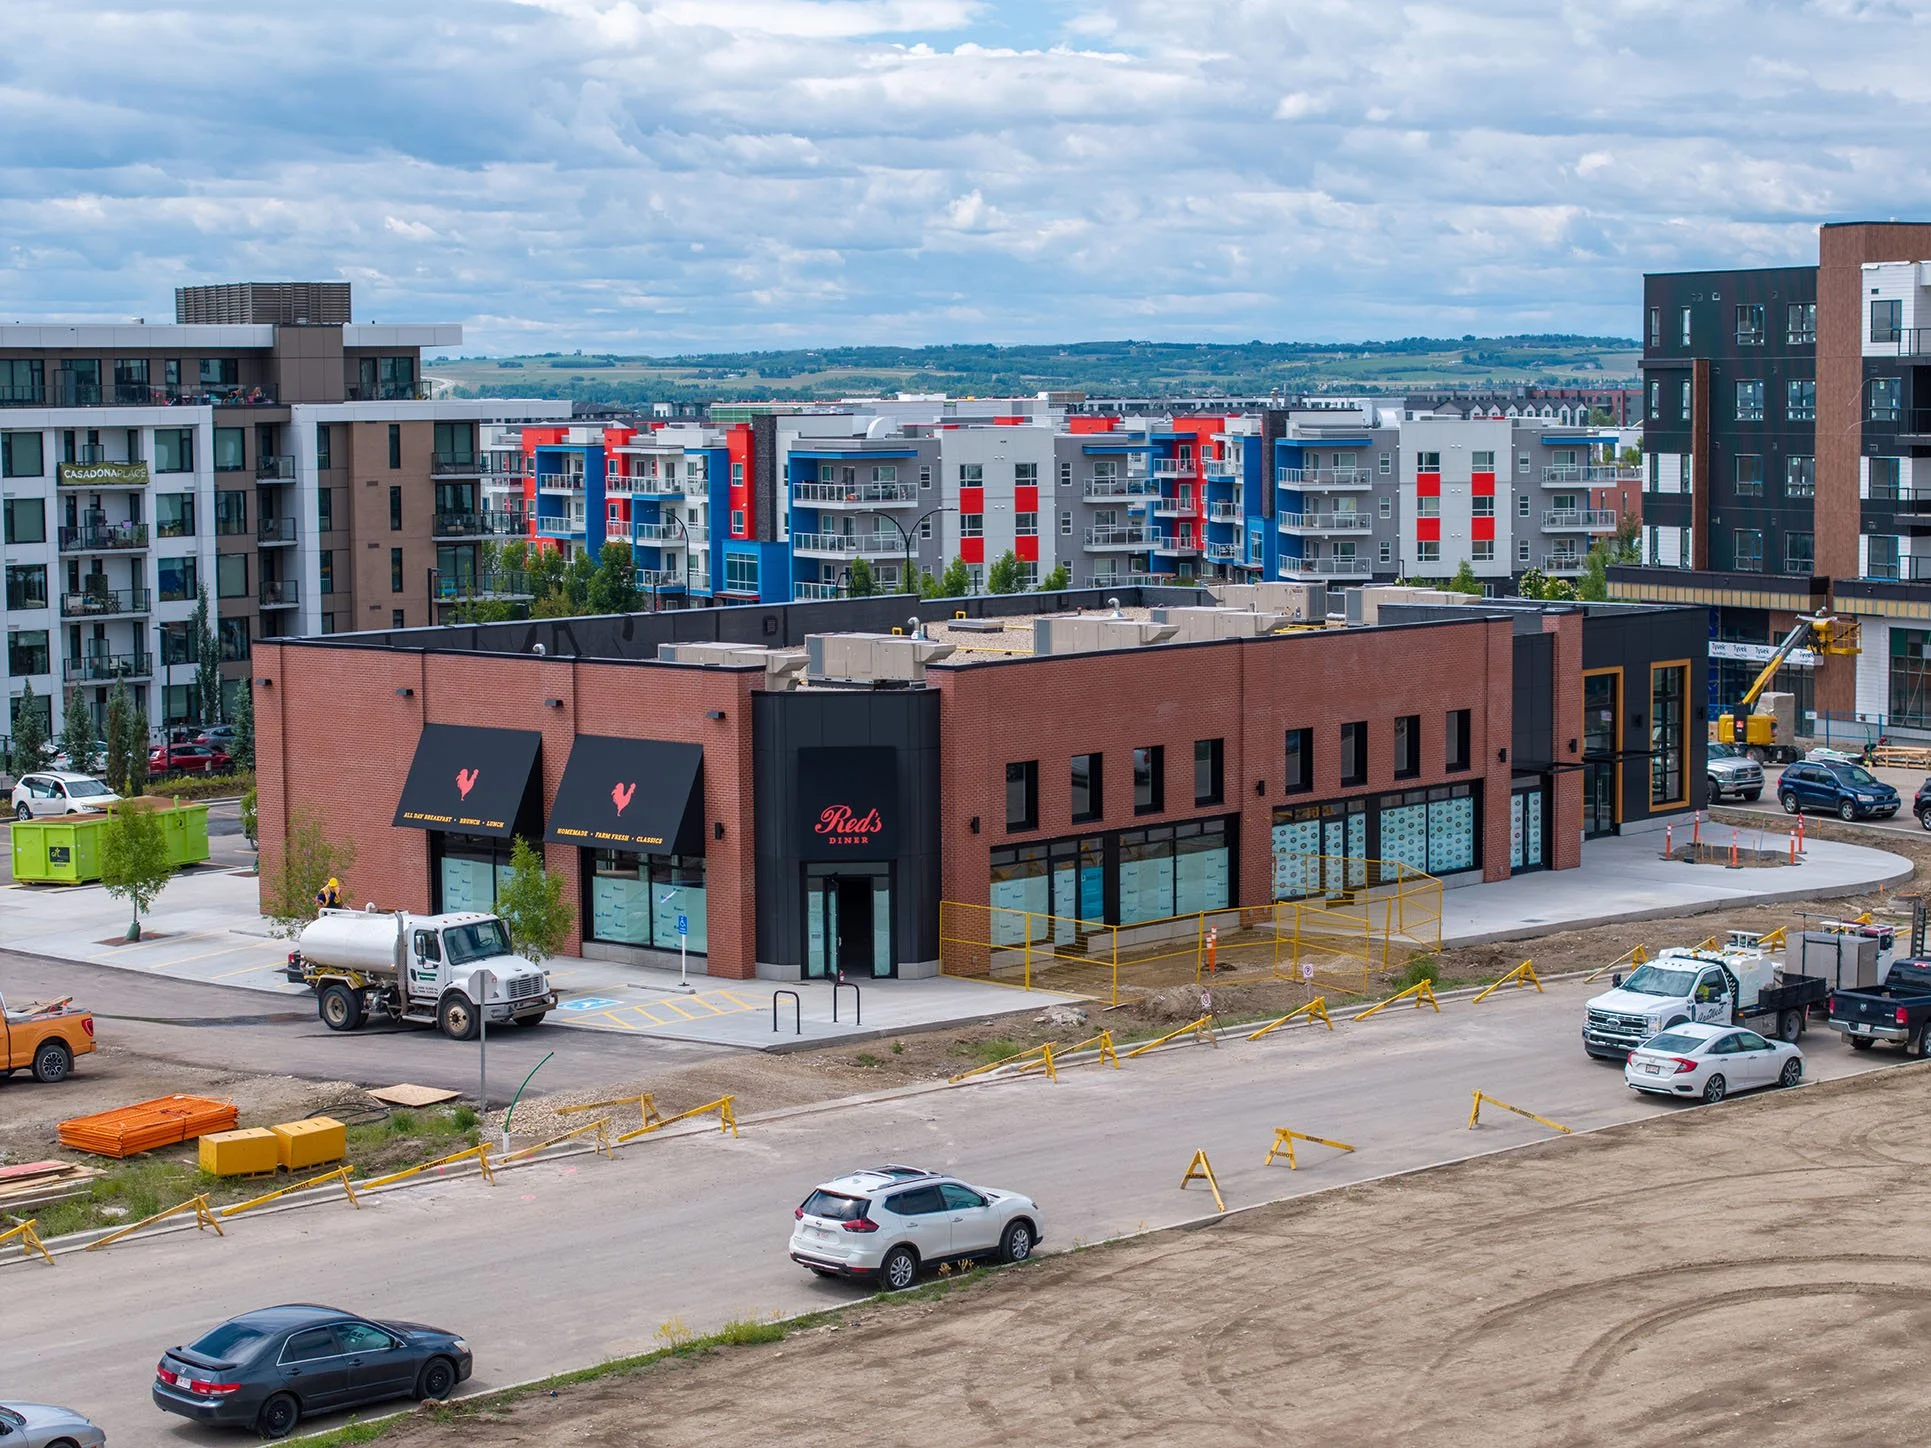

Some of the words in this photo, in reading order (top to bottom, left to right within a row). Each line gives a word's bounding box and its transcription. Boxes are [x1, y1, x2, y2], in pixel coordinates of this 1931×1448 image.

[403, 811, 413, 819] ALL
[413, 812, 424, 820] DAY
[424, 814, 453, 823] BREAKFAST
[459, 817, 481, 826] BRUNCH
[486, 820, 505, 828] LUNCH
[814, 804, 883, 834] Red's
[556, 828, 589, 837] HOMEMADE
[595, 831, 611, 840] FARM
[611, 833, 630, 841] FRESH
[635, 835, 664, 845] CLASSICS
[828, 836, 869, 845] DINER
[545, 1134, 572, 1147] MARMOT
[419, 1158, 448, 1172] MARMOT
[281, 1181, 311, 1196] MARMOT
